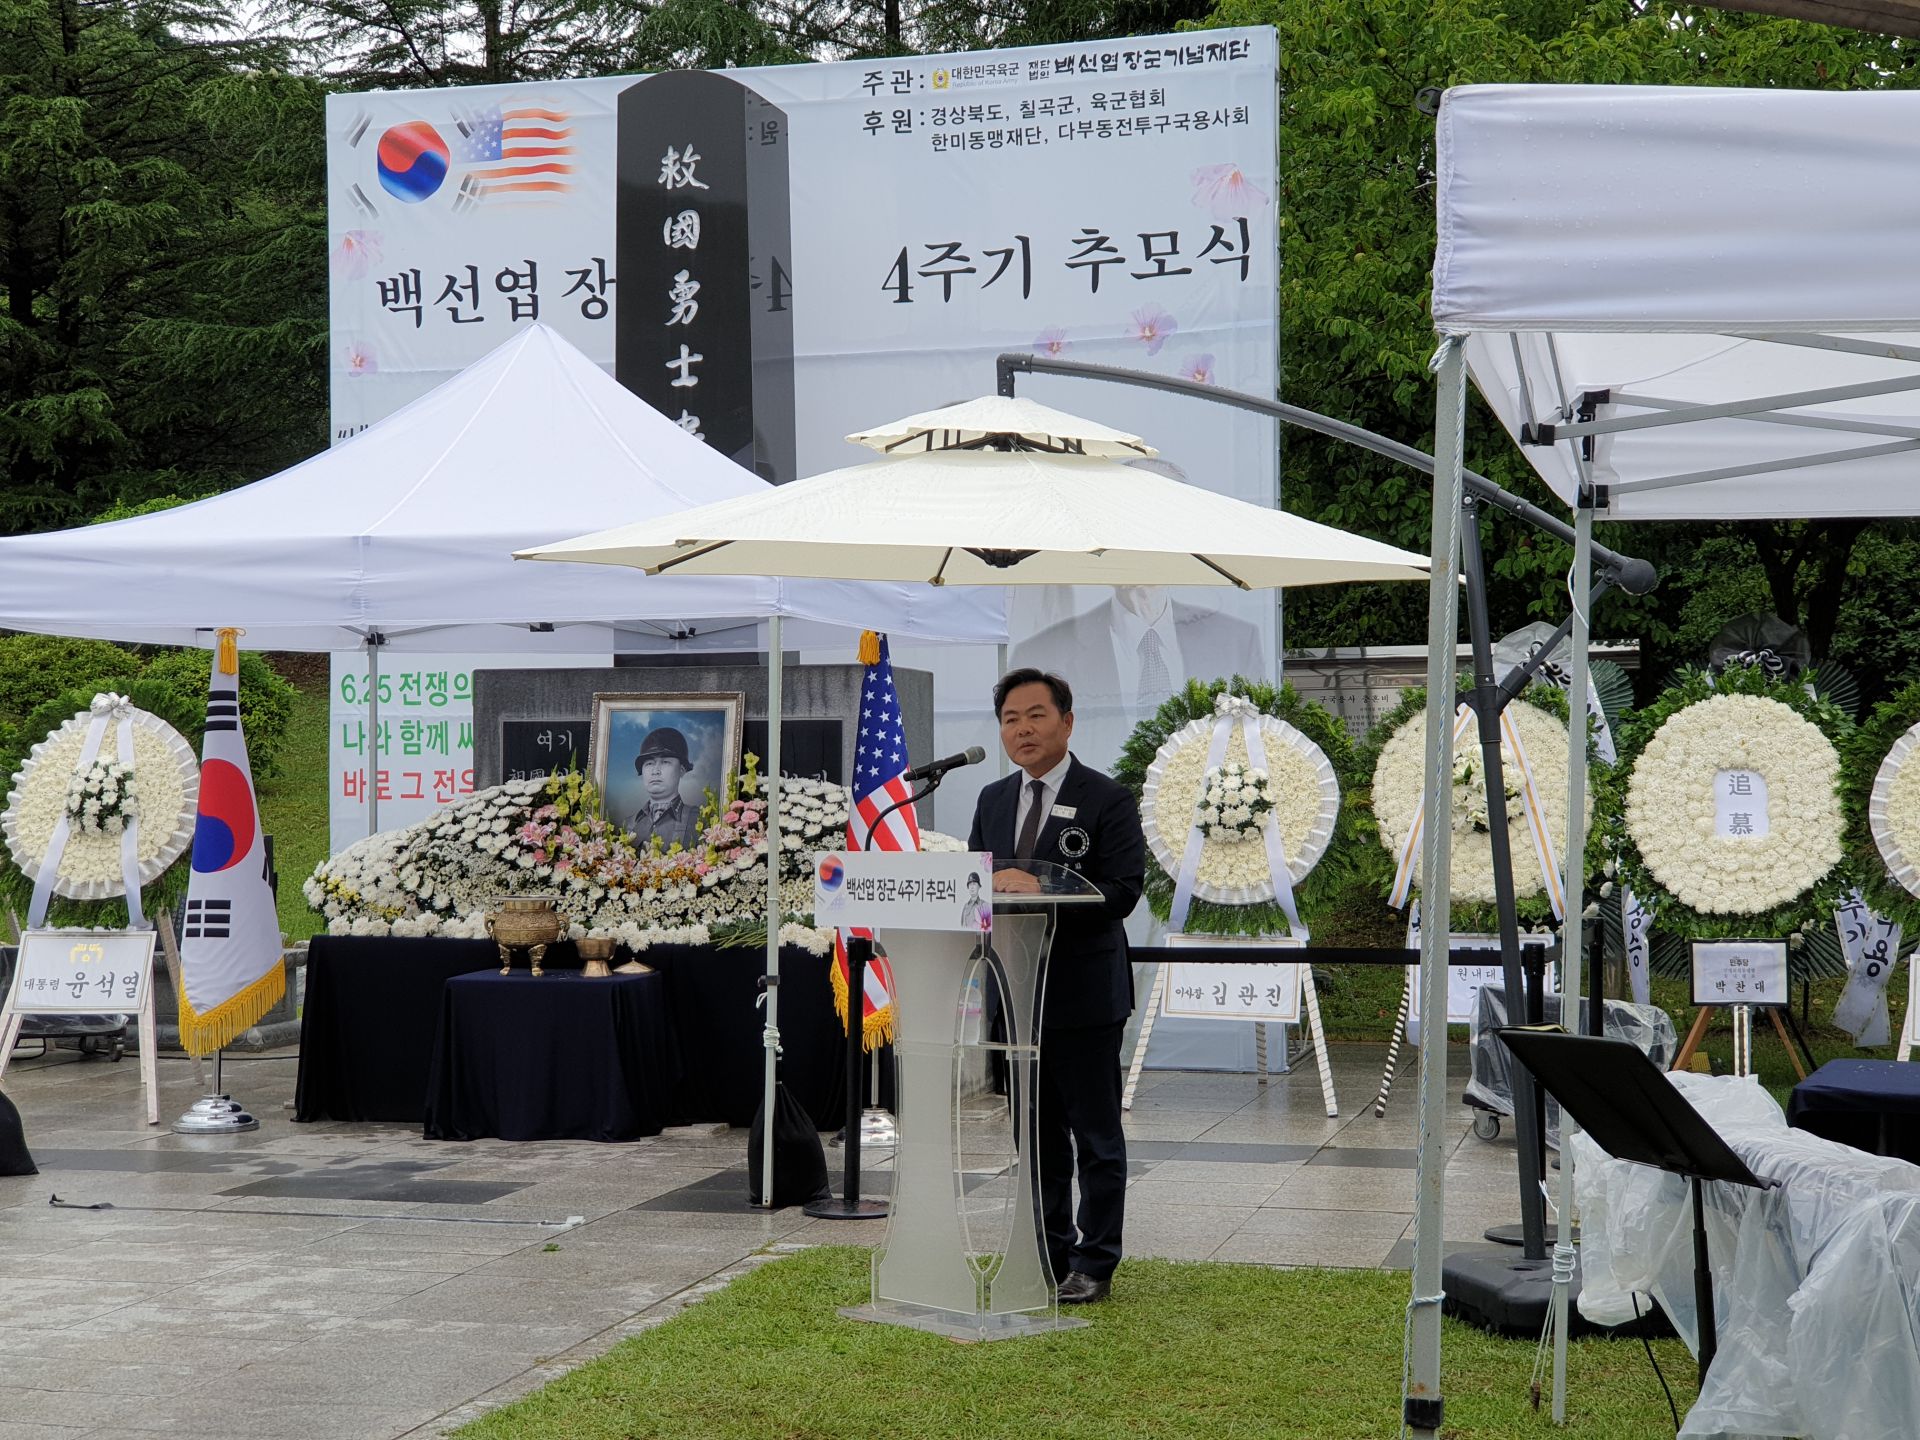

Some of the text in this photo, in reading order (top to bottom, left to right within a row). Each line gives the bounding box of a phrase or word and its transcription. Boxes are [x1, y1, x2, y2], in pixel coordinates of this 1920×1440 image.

[952, 62, 1020, 80] 대한민국육군
[1028, 59, 1050, 70] 재단
[1028, 70, 1050, 81] 법인
[931, 104, 1010, 126] 경상북도,
[1020, 95, 1081, 119] 칠곡군,
[1091, 88, 1165, 111] 육군협회
[931, 105, 1250, 152] 한미동맹재단, 다부동전투구국용사회
[375, 259, 541, 329] 백선엽
[881, 234, 1032, 303] 4주기
[1064, 217, 1251, 294] 추모식
[341, 673, 392, 705] 6.25
[343, 720, 392, 756] 나와
[399, 719, 449, 756] 함께
[536, 729, 573, 753] 여기
[343, 768, 393, 804] 바로
[400, 772, 425, 799] 그
[1728, 773, 1754, 836] 追慕
[846, 877, 957, 903] 백선엽 장군 4주기 추모식
[24, 971, 140, 999] 대통령 윤석열
[1456, 967, 1504, 982] 원내대
[1175, 981, 1281, 1007] 이사장 김관진
